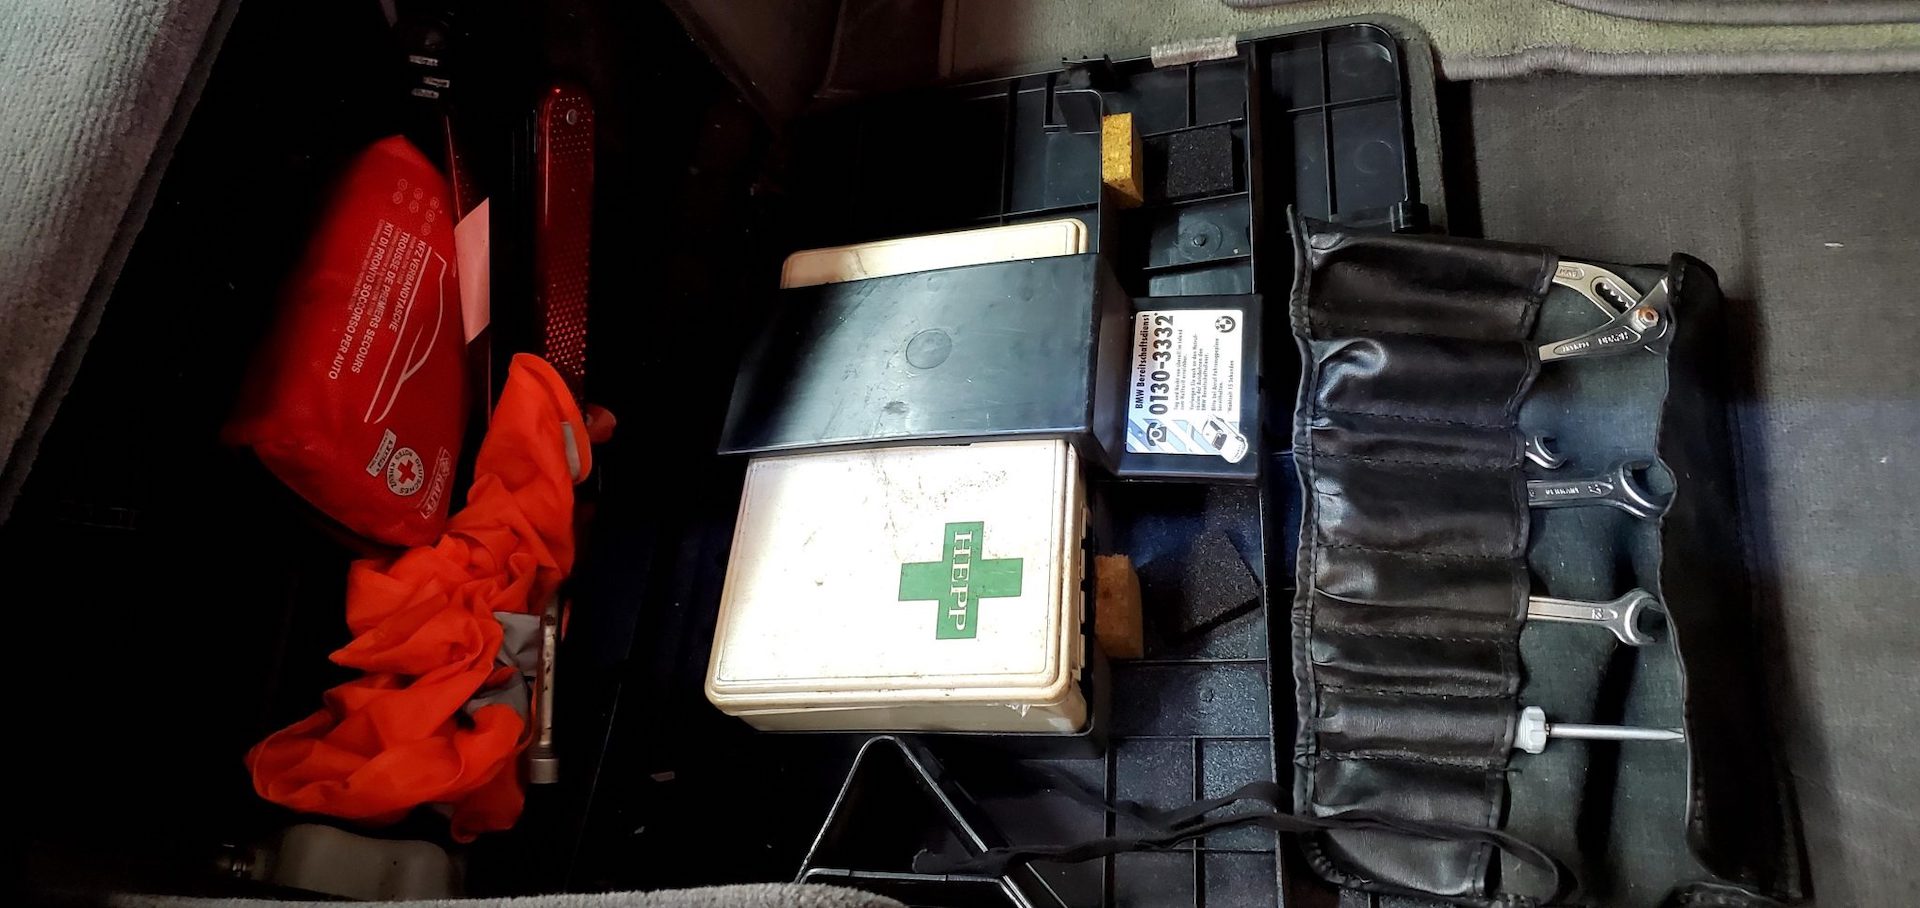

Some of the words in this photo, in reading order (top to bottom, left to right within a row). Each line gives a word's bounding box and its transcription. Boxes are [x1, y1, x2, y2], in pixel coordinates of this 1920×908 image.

[380, 237, 388, 250] DI
[383, 222, 394, 240] KIT
[365, 247, 386, 283] PRONTO
[389, 231, 411, 274] TROUSSE
[416, 239, 427, 260] KFZ
[385, 271, 396, 285] DE
[388, 259, 419, 333] VERBANDTASCHE
[346, 283, 373, 334] SOCCORSO
[369, 286, 390, 330] PREMIERS
[338, 333, 353, 354] PER
[351, 328, 375, 375] SECOURS
[1136, 314, 1150, 388] Bereitschaftsdienst
[328, 351, 345, 380] AUTO
[1135, 389, 1144, 409] BMW
[400, 458, 423, 494] DEUTSCHES
[948, 531, 973, 631] HEPP
